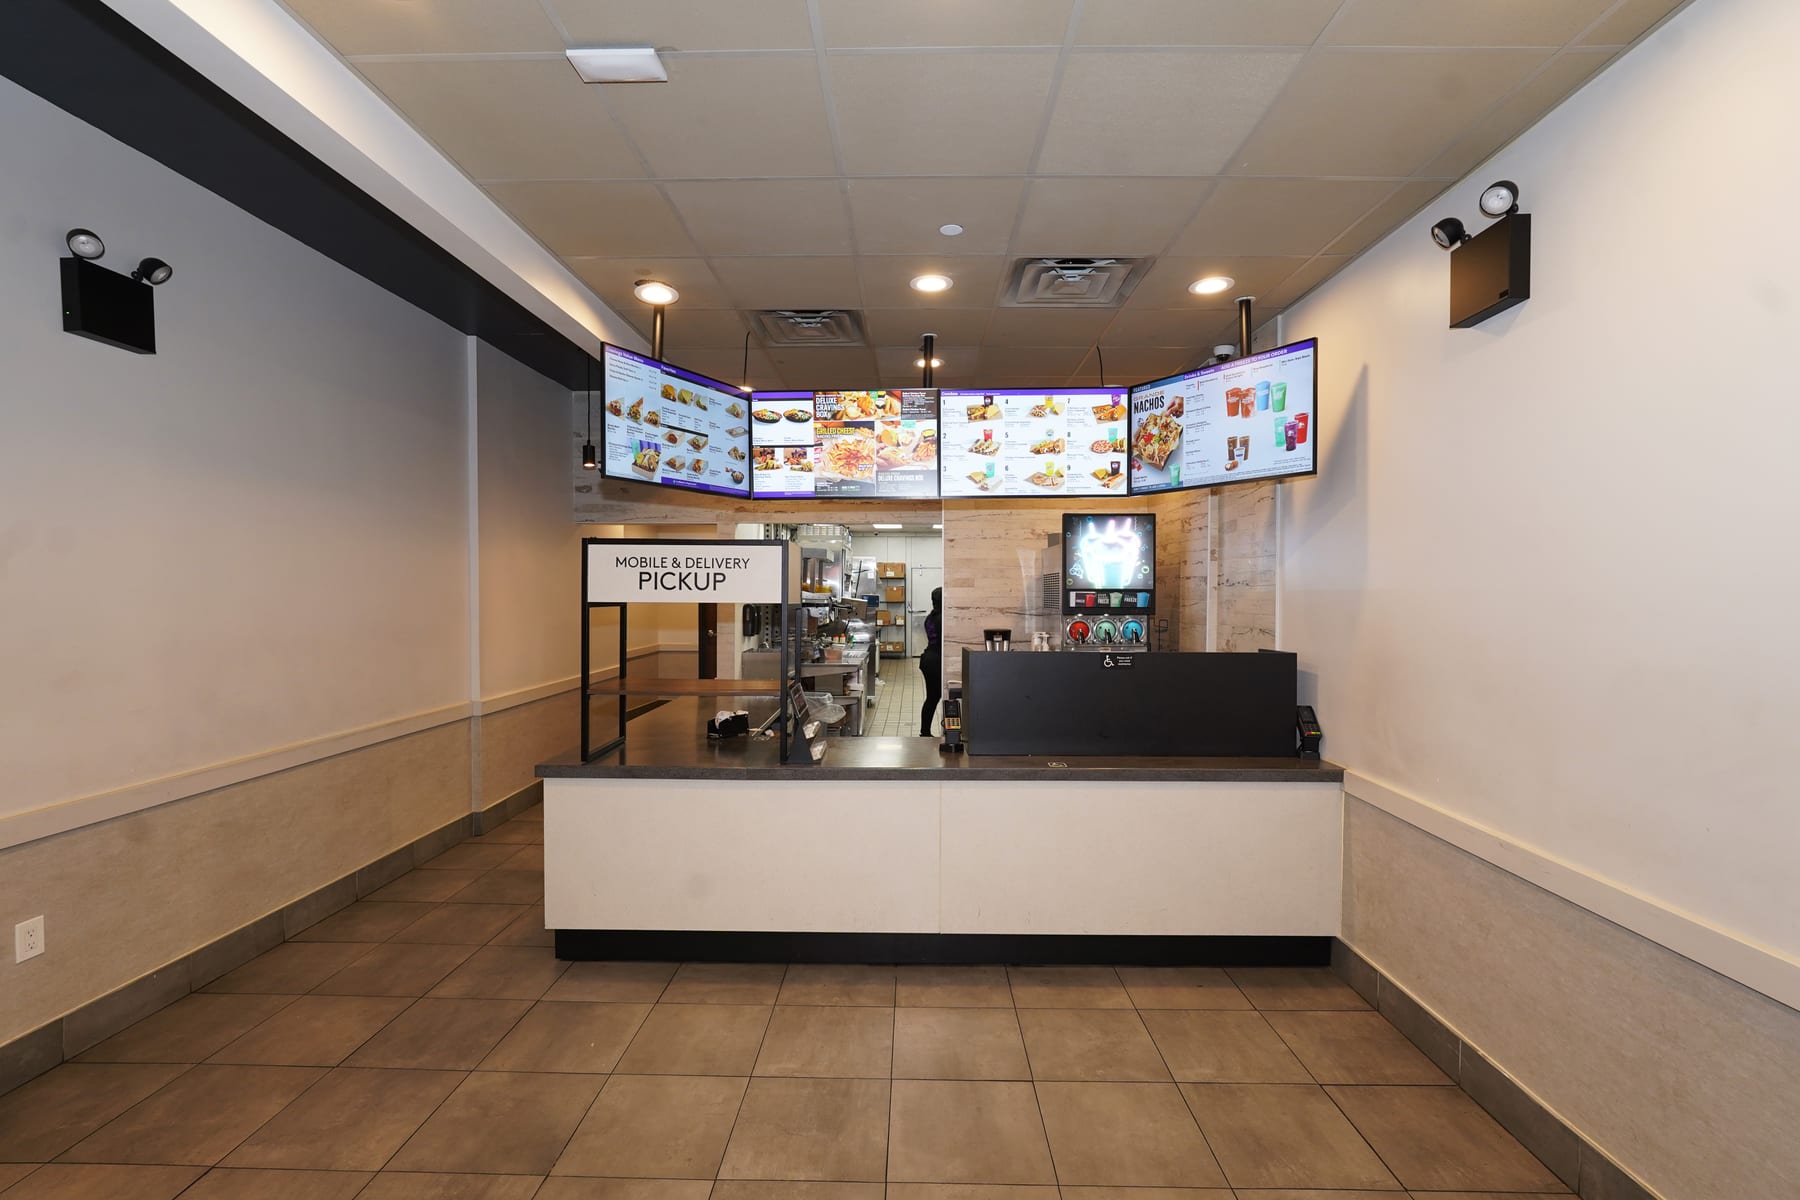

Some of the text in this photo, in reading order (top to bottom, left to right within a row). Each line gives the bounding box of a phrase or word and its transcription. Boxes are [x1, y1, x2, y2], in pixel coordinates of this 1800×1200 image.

[1235, 357, 1251, 367] FREEZE
[1270, 348, 1288, 358] ORDER
[1200, 368, 1215, 376] Sweets
[1133, 384, 1151, 393] FEATURED
[1133, 390, 1165, 401] GRANDE
[1133, 395, 1165, 415] NACHOS
[816, 427, 855, 435] GRILLED CHEESE
[615, 556, 750, 570] MOBILE & DELIVERY
[638, 571, 727, 591] PICKUP
